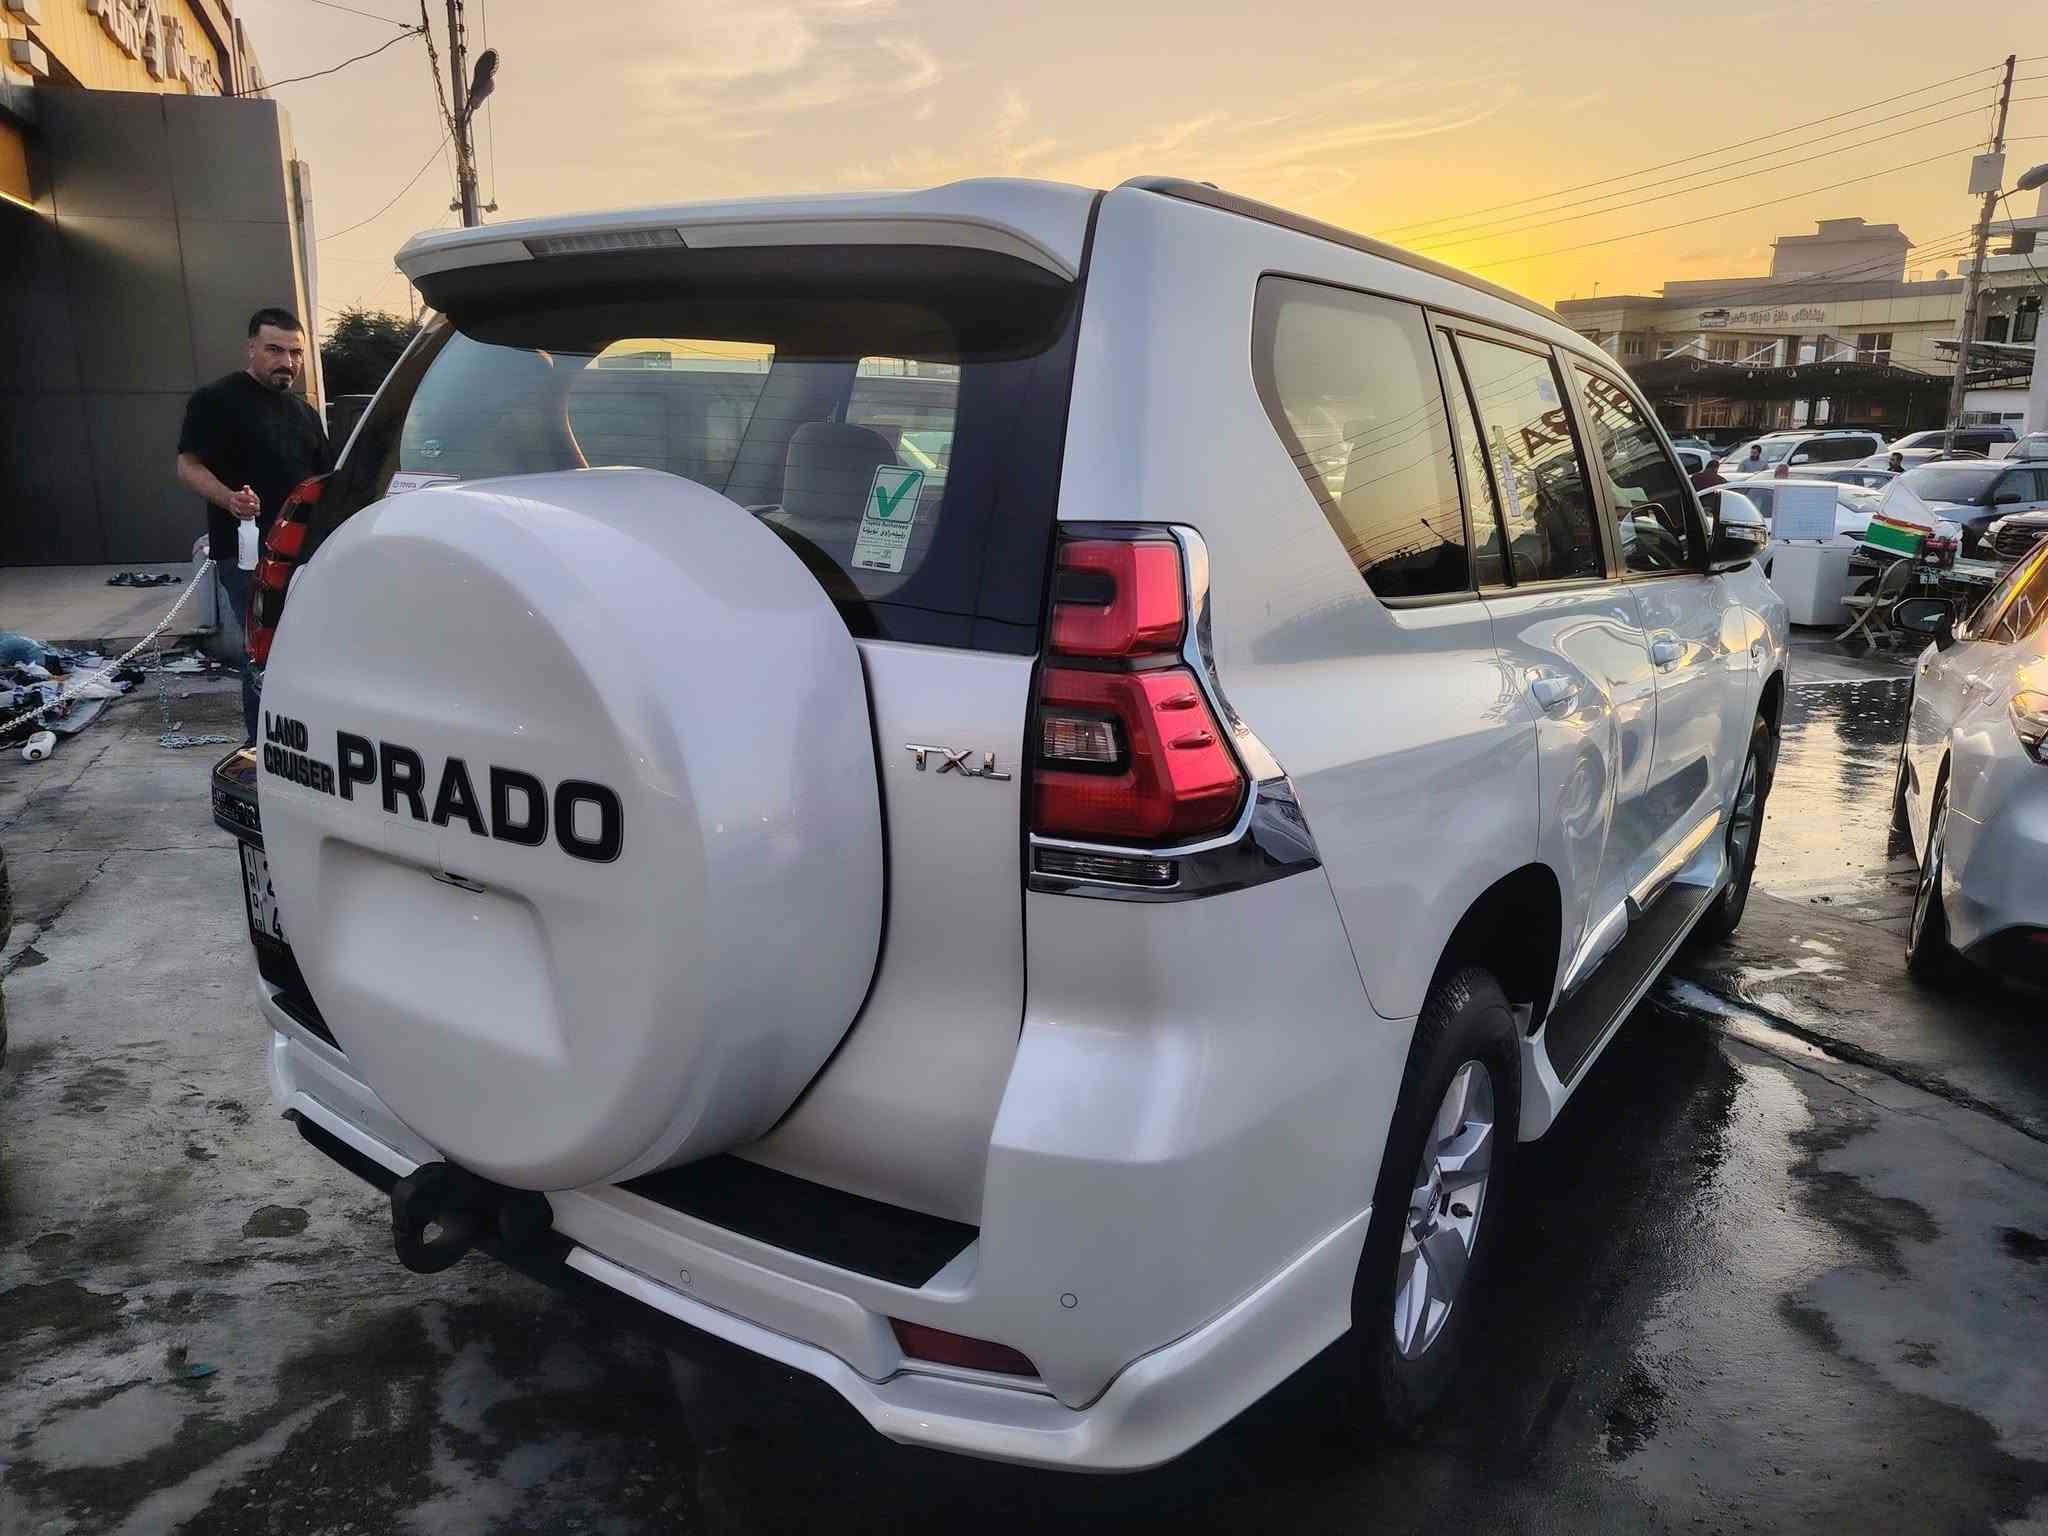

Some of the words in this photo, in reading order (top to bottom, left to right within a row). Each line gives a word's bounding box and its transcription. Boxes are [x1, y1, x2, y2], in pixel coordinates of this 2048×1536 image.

[264, 709, 309, 753] LAND
[262, 742, 336, 797] CRUISER
[904, 743, 1012, 782] TXL
[335, 729, 625, 864] PRADO
